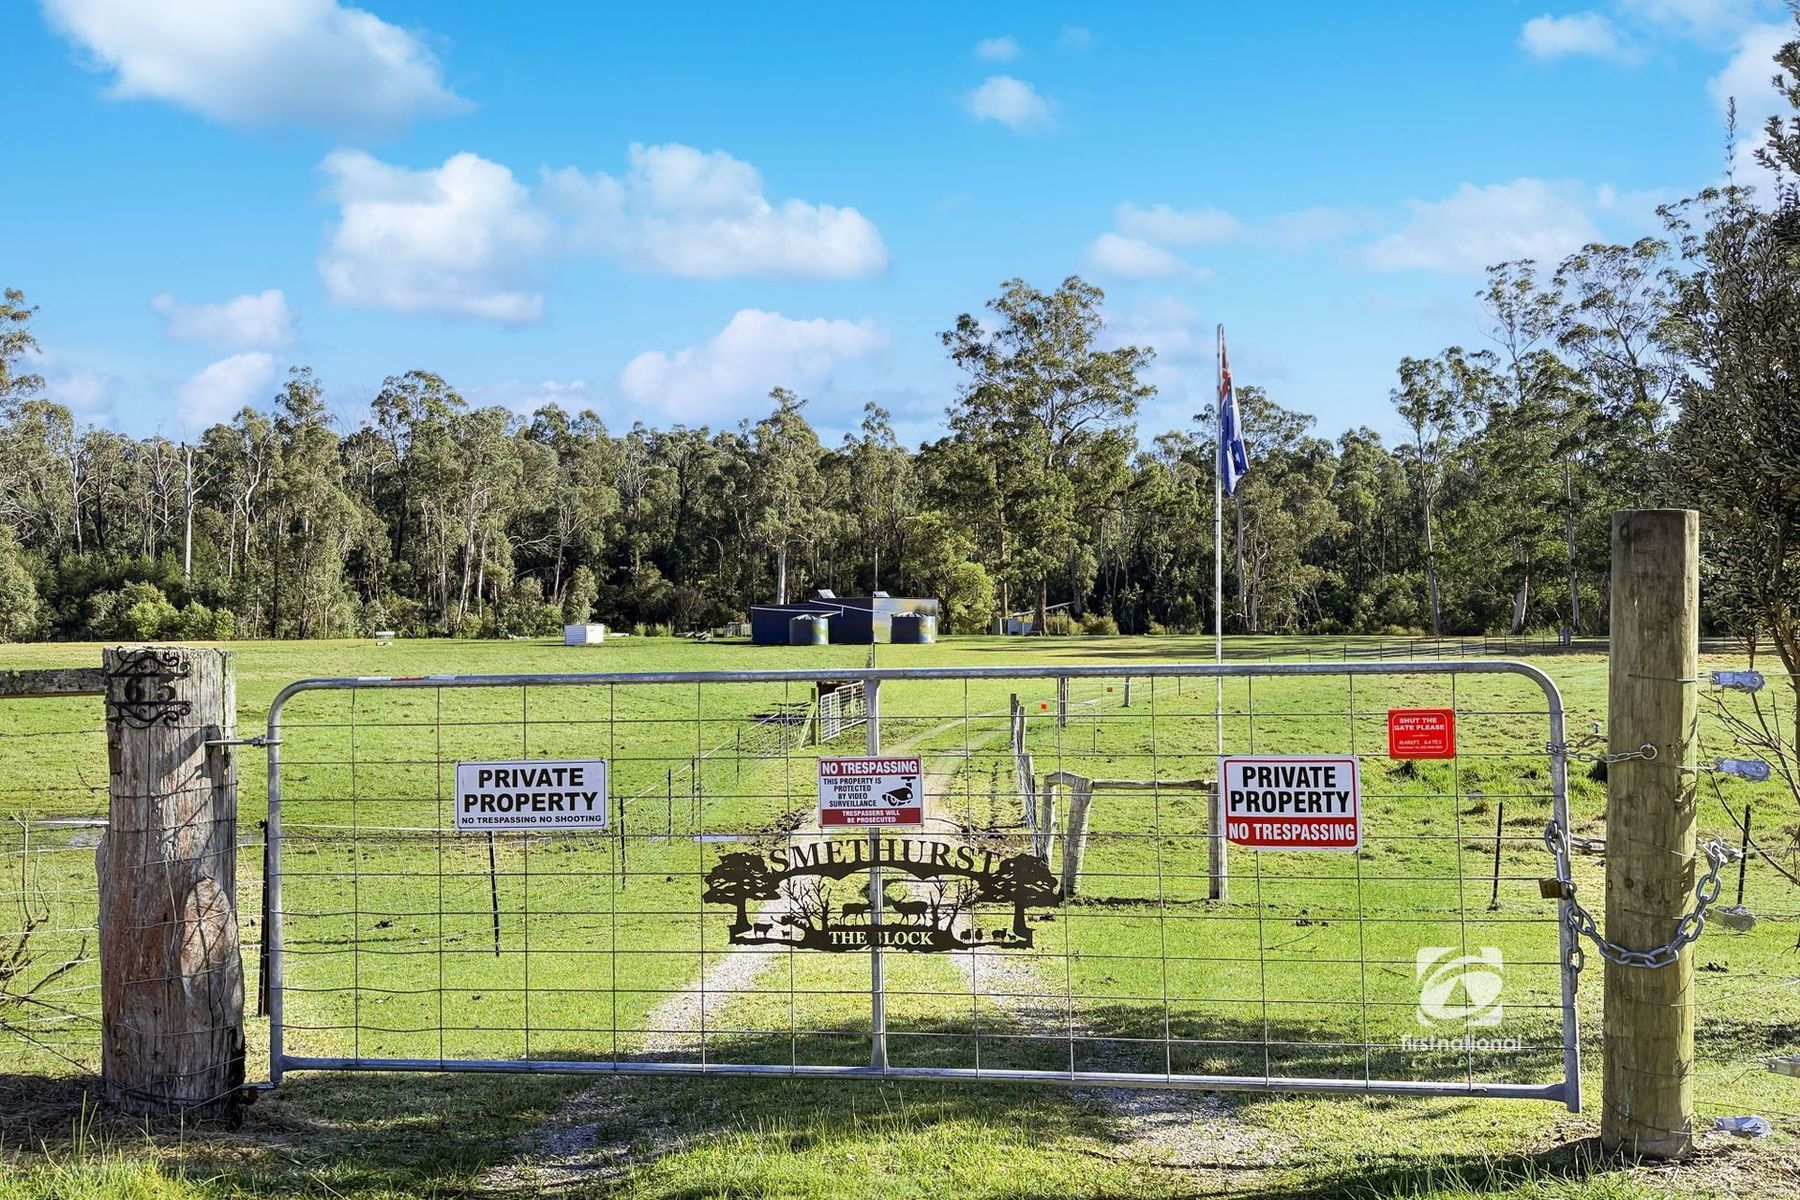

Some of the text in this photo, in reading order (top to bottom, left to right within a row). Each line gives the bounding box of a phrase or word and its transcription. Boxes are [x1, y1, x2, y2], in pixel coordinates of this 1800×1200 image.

[822, 760, 918, 774] NO TRESPASSING
[1242, 766, 1336, 788] PRIVATE
[478, 768, 584, 788] PRIVATE
[464, 792, 598, 813] PROPERTY
[1230, 790, 1350, 813] PROPERTY
[1228, 822, 1356, 840] NO TRESPASSING
[768, 838, 1001, 875] SMETHURST
[828, 931, 868, 945] THE
